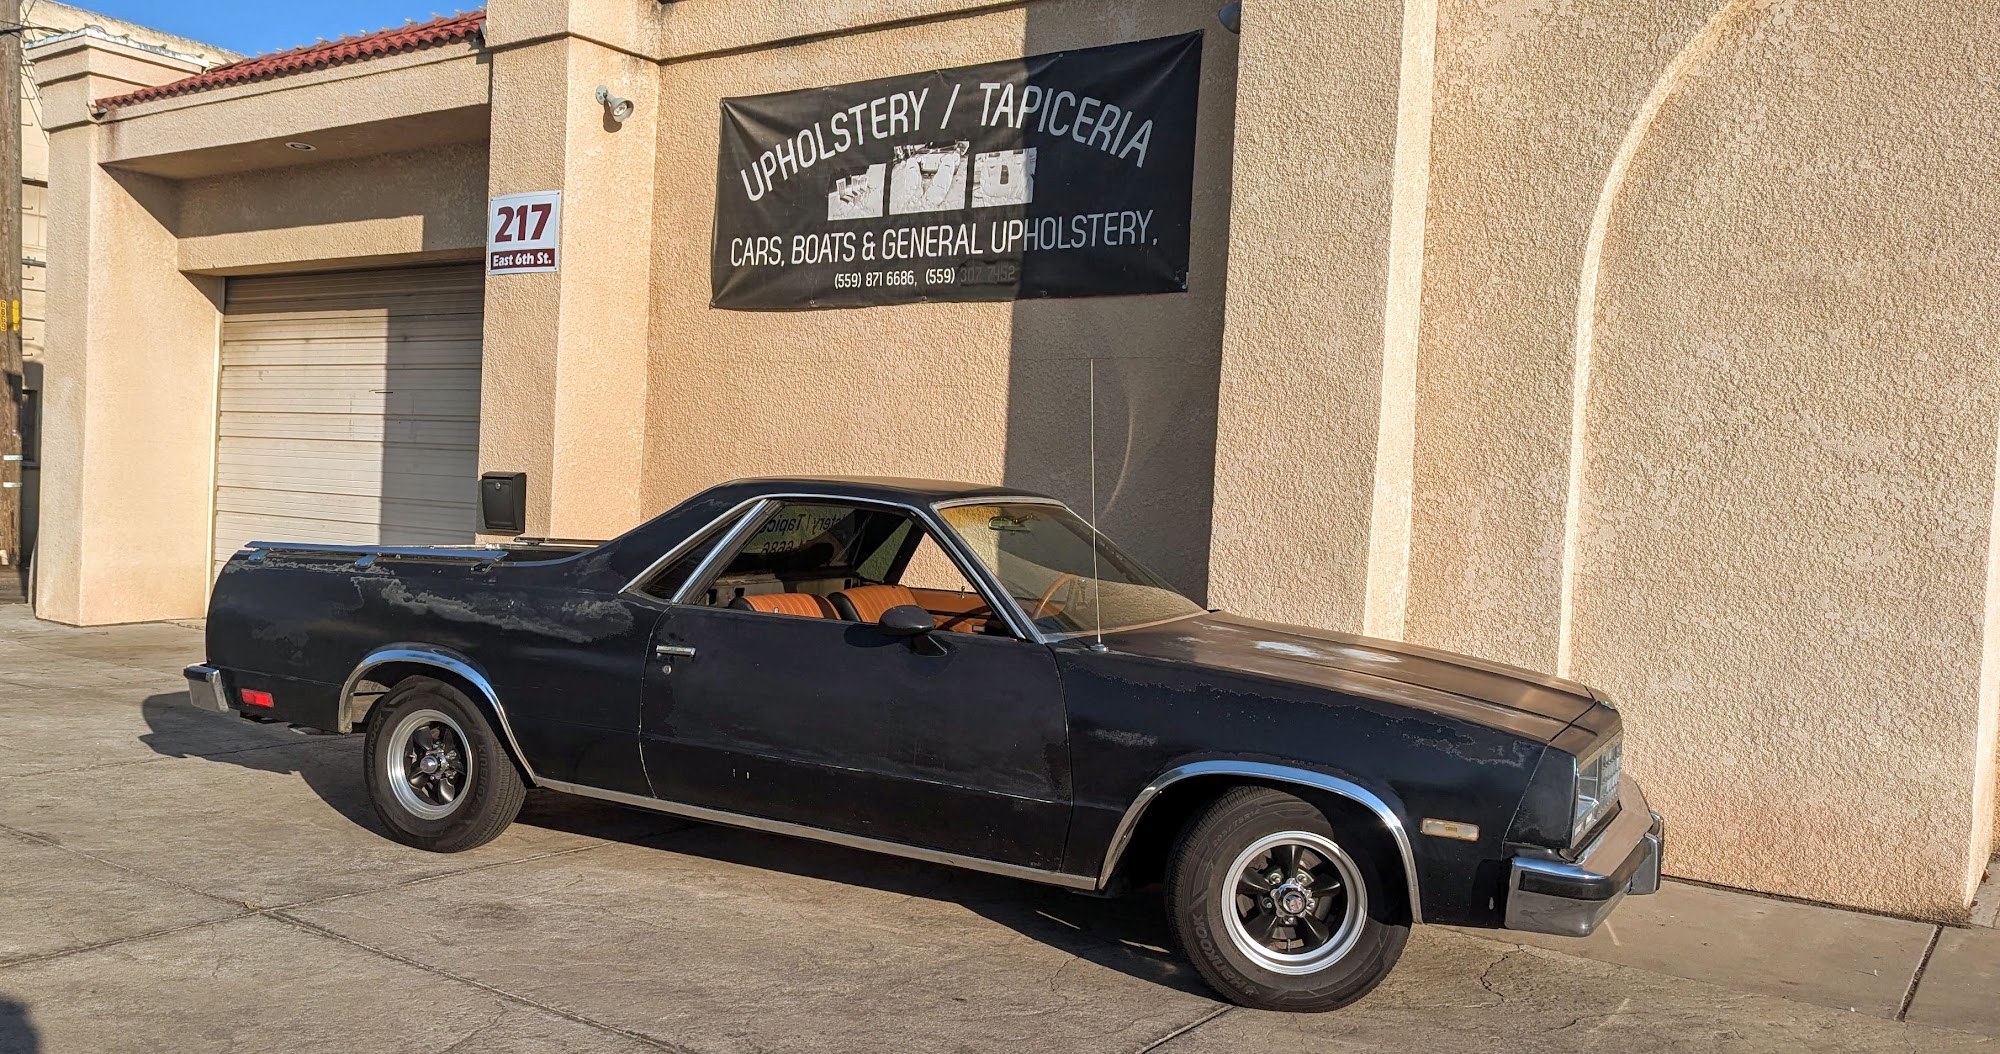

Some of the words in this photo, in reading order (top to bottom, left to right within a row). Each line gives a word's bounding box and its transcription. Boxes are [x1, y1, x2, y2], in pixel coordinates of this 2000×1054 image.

[740, 87, 929, 202] UPHOLSTERY
[939, 83, 961, 130] /
[979, 81, 1154, 168] TAPICERIA
[494, 203, 552, 243] 217
[730, 236, 785, 267] CARS,
[791, 232, 856, 265] BOATS
[862, 233, 875, 260] &
[882, 222, 983, 259] GENERAL
[991, 209, 1158, 252] UPHOLSTERY,
[493, 254, 513, 267] East
[515, 252, 535, 265] 6th
[536, 252, 552, 265] St.
[834, 272, 862, 288] (559)
[865, 271, 884, 287] 871
[886, 269, 918, 287] 6686,
[925, 267, 956, 285] (559)
